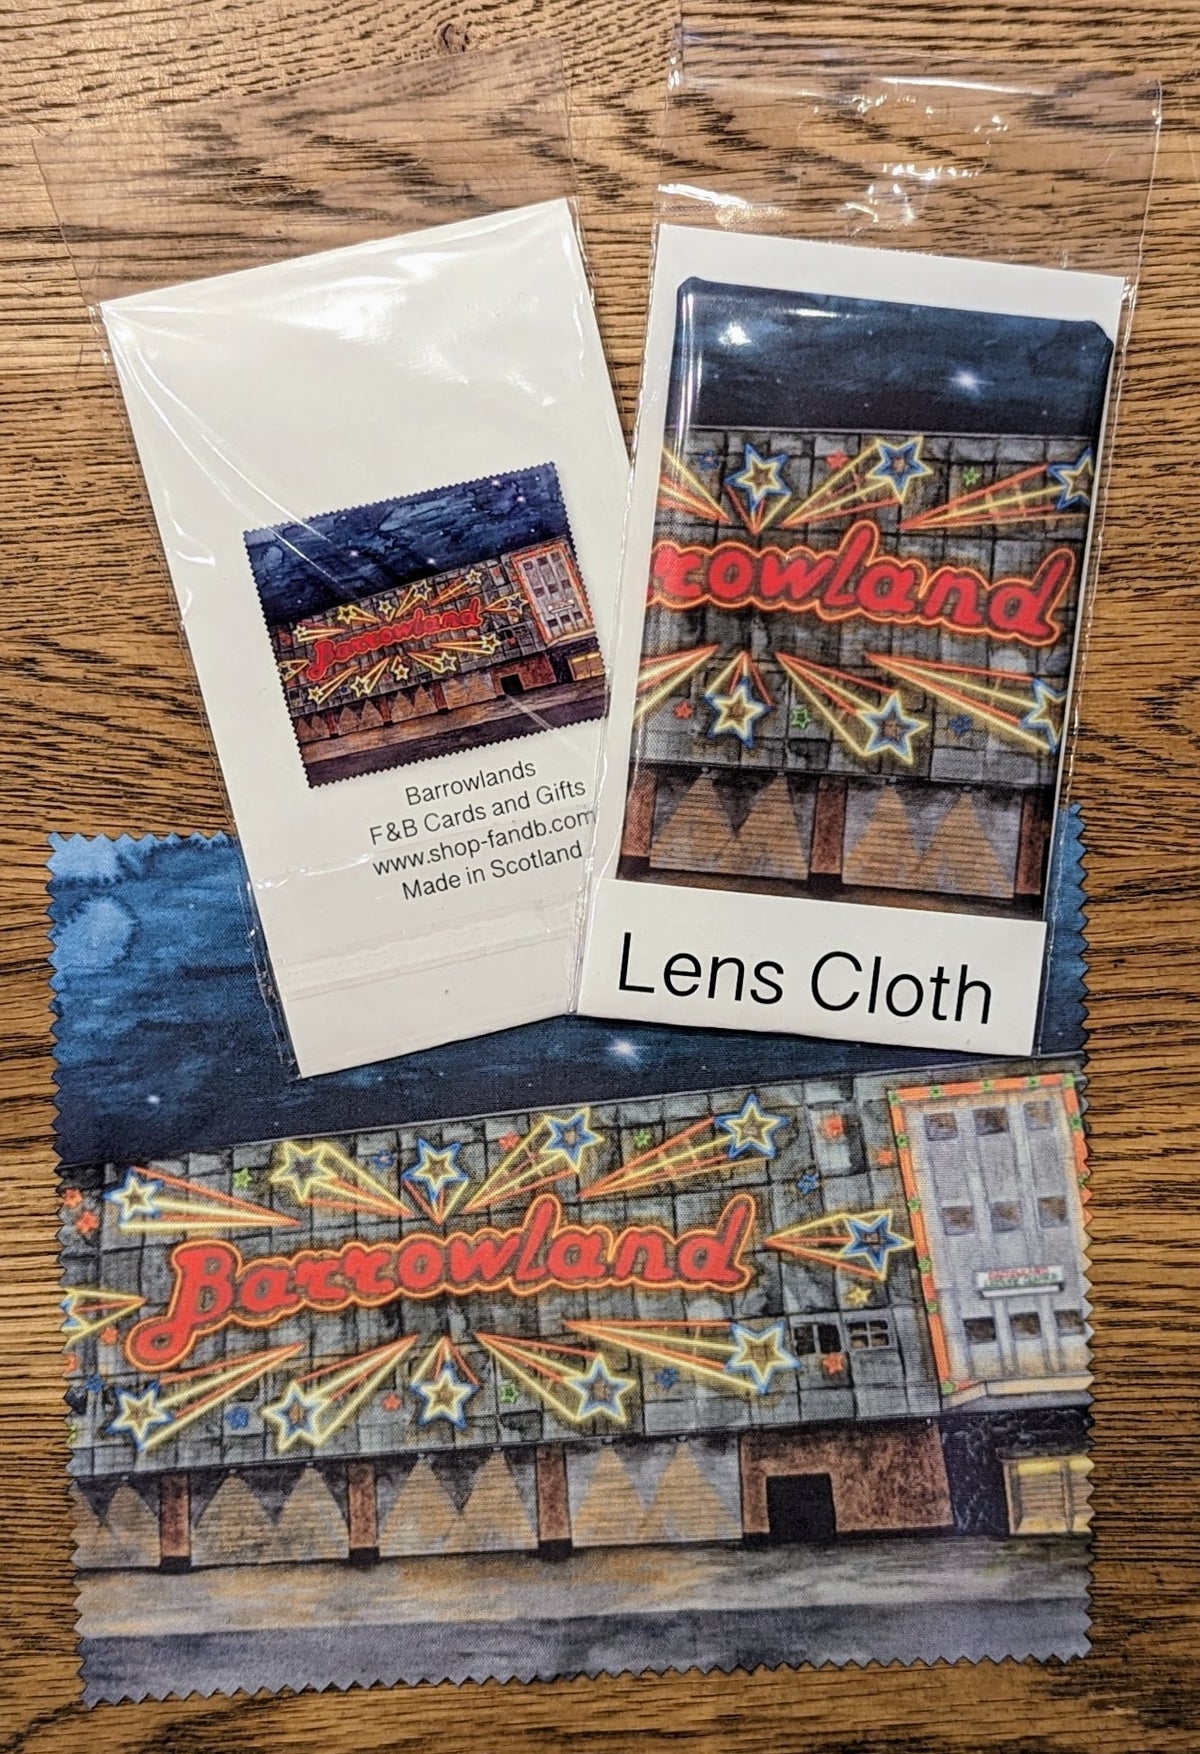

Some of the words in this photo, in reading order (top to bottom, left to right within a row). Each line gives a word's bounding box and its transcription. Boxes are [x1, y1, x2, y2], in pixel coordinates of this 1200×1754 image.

[647, 520, 1075, 646] rowland
[307, 597, 483, 681] Barrowland
[369, 818, 418, 846] F&B
[423, 804, 487, 833] Cards
[492, 790, 530, 817] and
[536, 781, 587, 806] Gifts
[405, 760, 537, 806] Barrowlands
[372, 809, 597, 876] www.shop-fandb.com
[402, 872, 461, 901] Made
[465, 866, 486, 885] in
[490, 840, 583, 879] Scotland
[618, 931, 785, 1005] Lens
[810, 950, 993, 1025] Cloth
[126, 1193, 756, 1372] Barrowland
